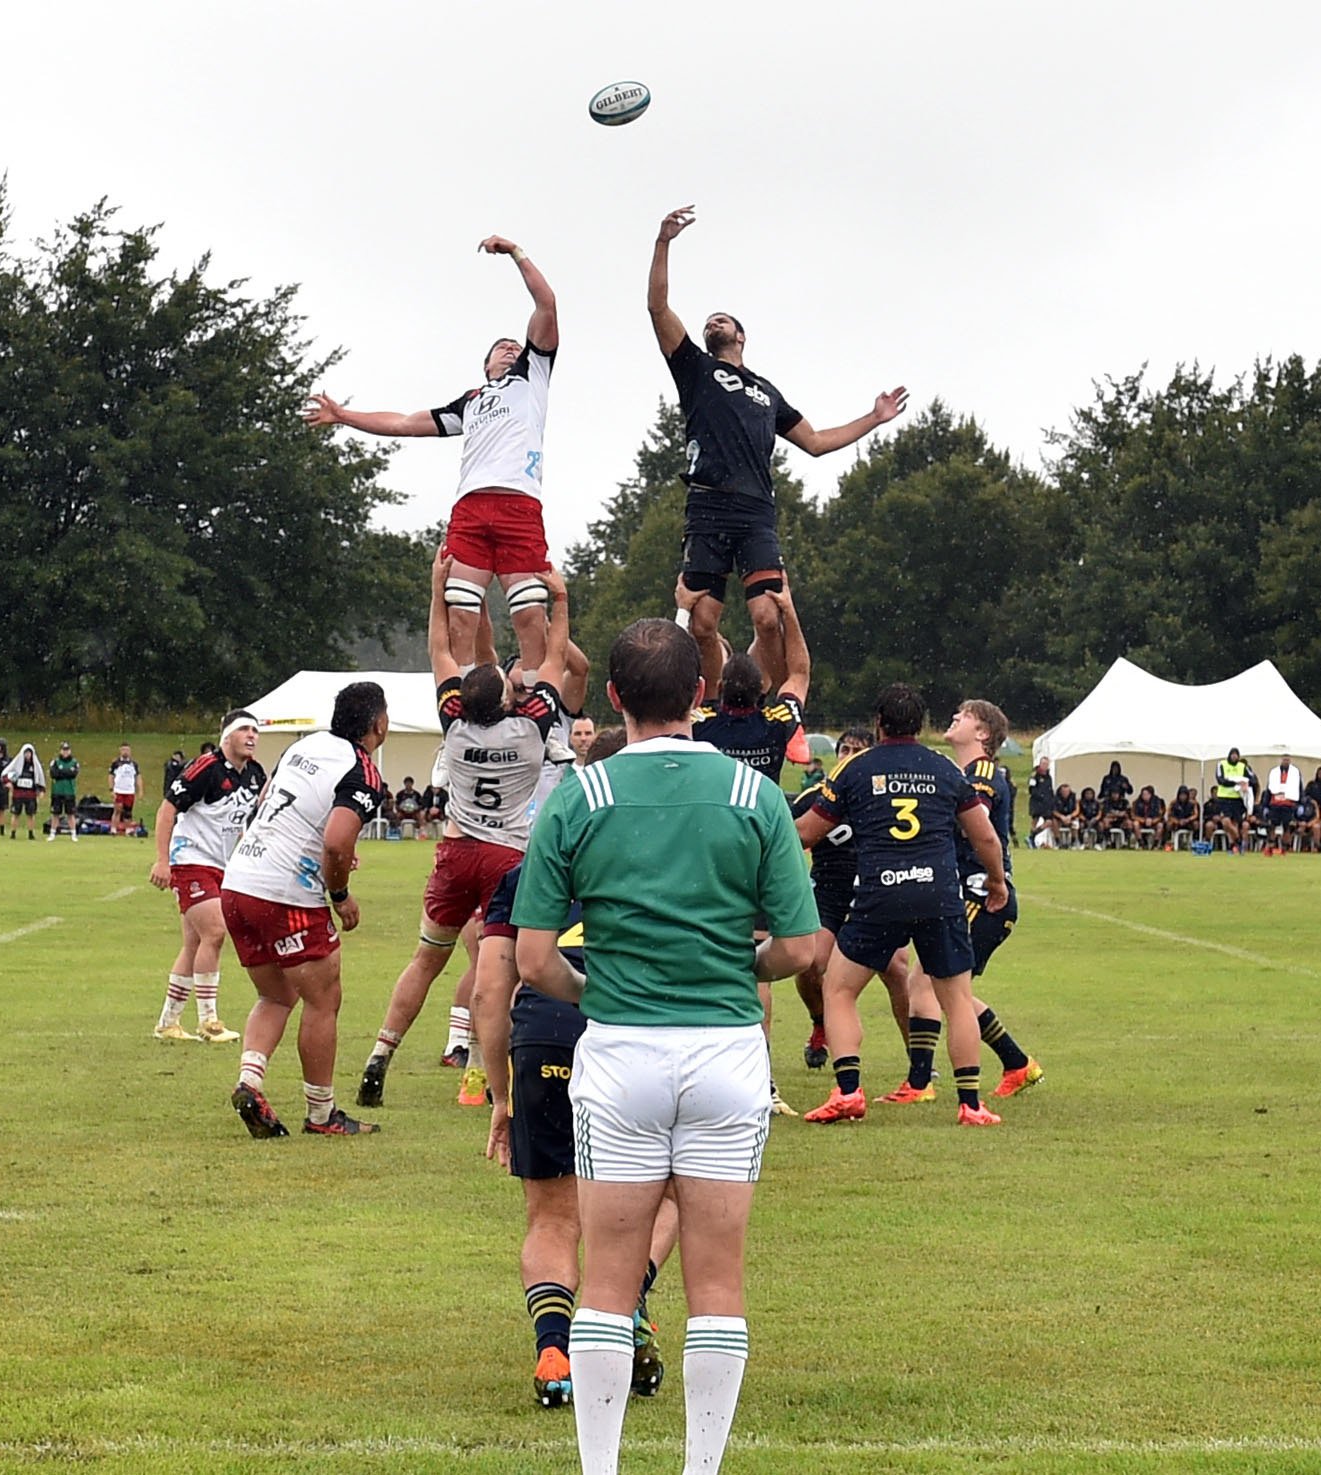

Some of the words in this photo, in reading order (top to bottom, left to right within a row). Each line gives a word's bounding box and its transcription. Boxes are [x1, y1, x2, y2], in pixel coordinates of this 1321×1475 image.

[596, 88, 643, 110] GILBERT
[489, 753, 519, 764] GIB
[299, 759, 319, 776] GIB
[888, 773, 936, 782] UNIVERSITY
[473, 776, 502, 811] 5
[888, 780, 936, 794] OTAGO
[352, 791, 375, 813] sky
[888, 798, 921, 841] 3
[238, 842, 268, 858] infor
[896, 866, 933, 884] pulse
[274, 932, 305, 956] CAT
[540, 1064, 572, 1080] STO
